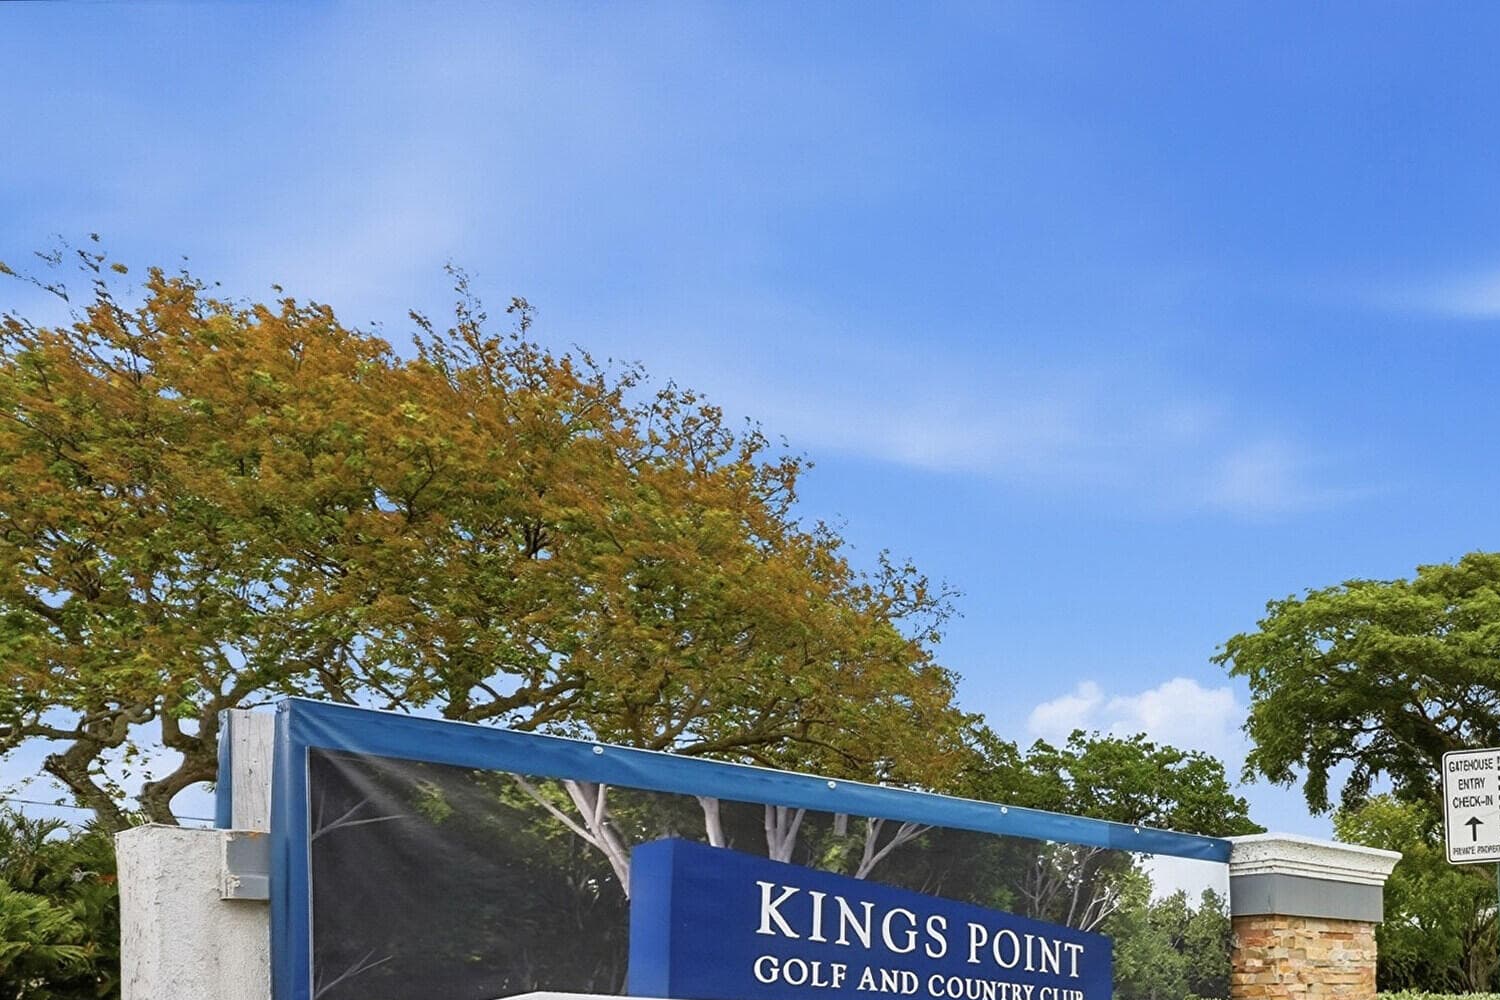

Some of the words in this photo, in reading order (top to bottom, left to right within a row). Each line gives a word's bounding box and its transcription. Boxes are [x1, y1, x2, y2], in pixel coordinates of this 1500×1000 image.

[1449, 758, 1493, 772] GATEHOUSE
[1458, 777, 1485, 790] ENTRY
[1453, 795, 1493, 808] CHECK-IN
[1453, 847, 1475, 855] PRIVATE
[755, 881, 947, 958] KINGS
[967, 923, 1084, 978] POINT
[753, 955, 847, 988] GOLF
[856, 966, 919, 995] AND
